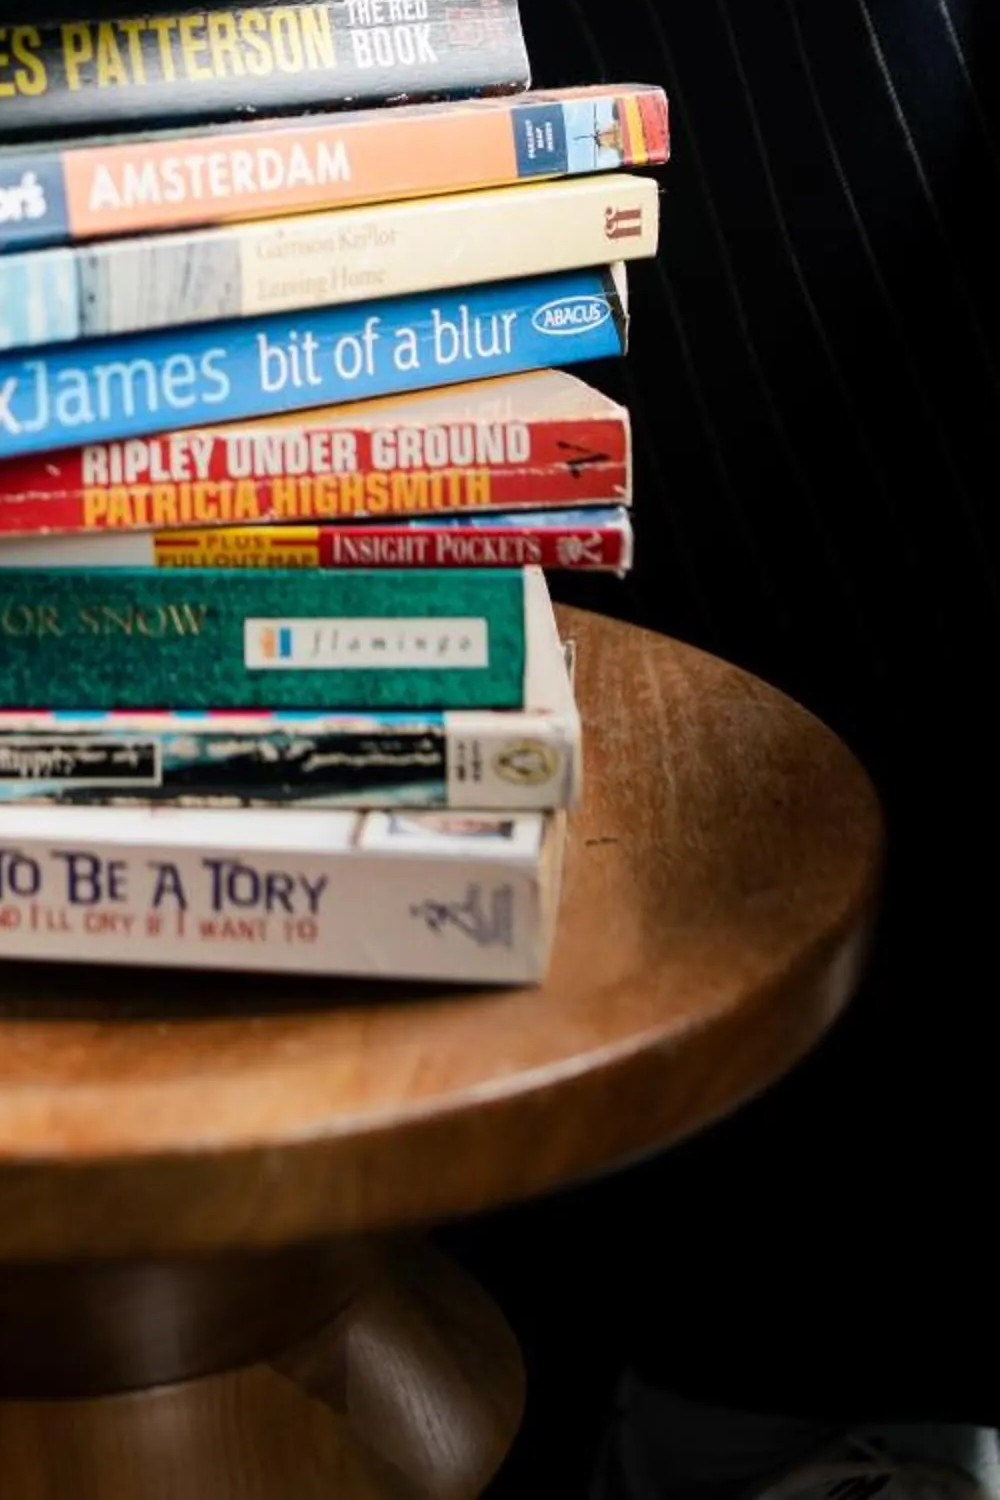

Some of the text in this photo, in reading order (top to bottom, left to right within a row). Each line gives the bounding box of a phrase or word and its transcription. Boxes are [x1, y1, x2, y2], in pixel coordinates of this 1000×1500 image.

[61, 3, 337, 92] PATTERSON
[352, 23, 438, 69] BOOK
[88, 139, 351, 212] AMSTERDAM
[331, 265, 388, 290] Home
[543, 303, 601, 328] ABACUS
[257, 329, 322, 393] bit
[333, 316, 382, 381] of
[393, 326, 421, 373] a
[431, 303, 518, 365] blur
[82, 421, 531, 486] RIPLEY UNDER GROUND
[83, 467, 491, 529] PATRICIA HIGHSMITH
[206, 534, 266, 551] PLUS
[78, 603, 207, 637] SNOW
[148, 859, 188, 912] A
